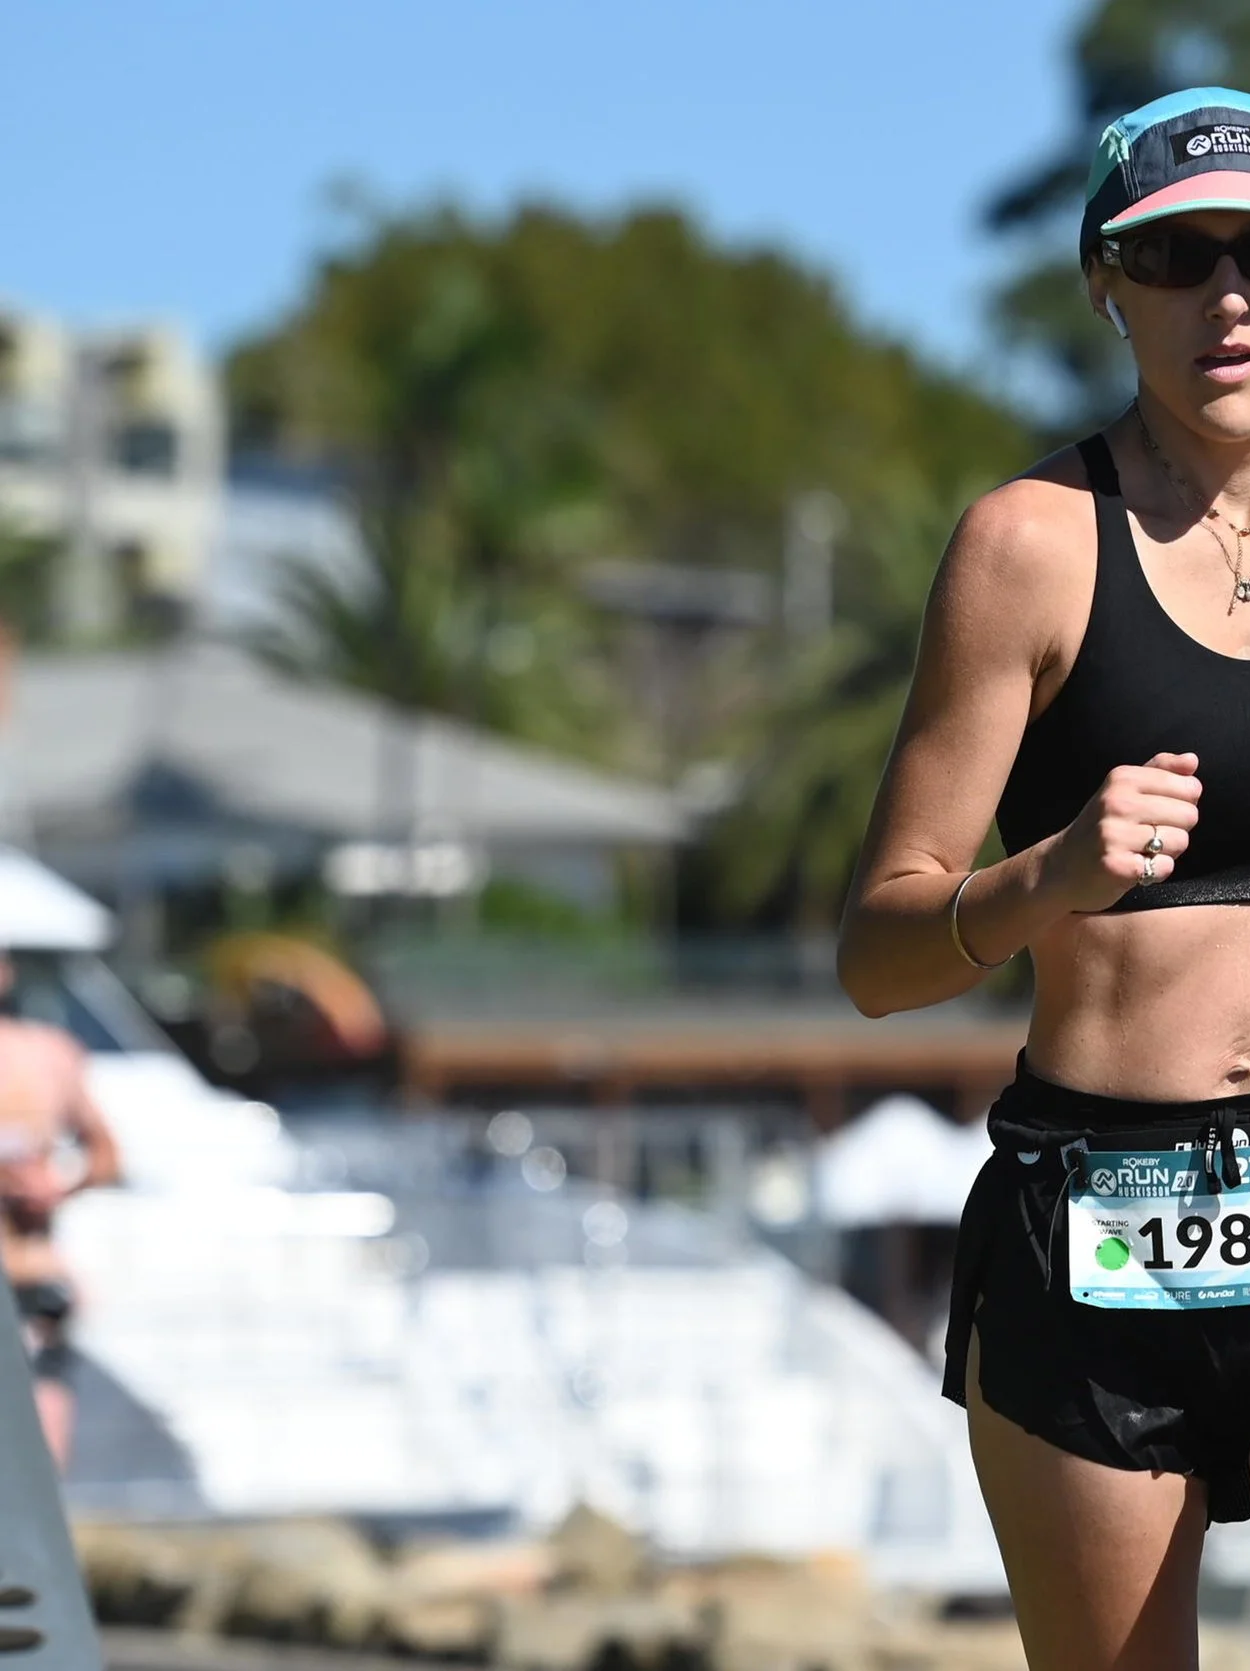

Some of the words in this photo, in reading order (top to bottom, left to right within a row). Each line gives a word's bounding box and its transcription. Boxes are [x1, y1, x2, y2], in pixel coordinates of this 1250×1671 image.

[1123, 1158, 1160, 1168] ROKEBY
[1117, 1168, 1169, 1185] RUN
[1177, 1176, 1194, 1188] 2.0
[1118, 1186, 1170, 1197] HUSKISSON
